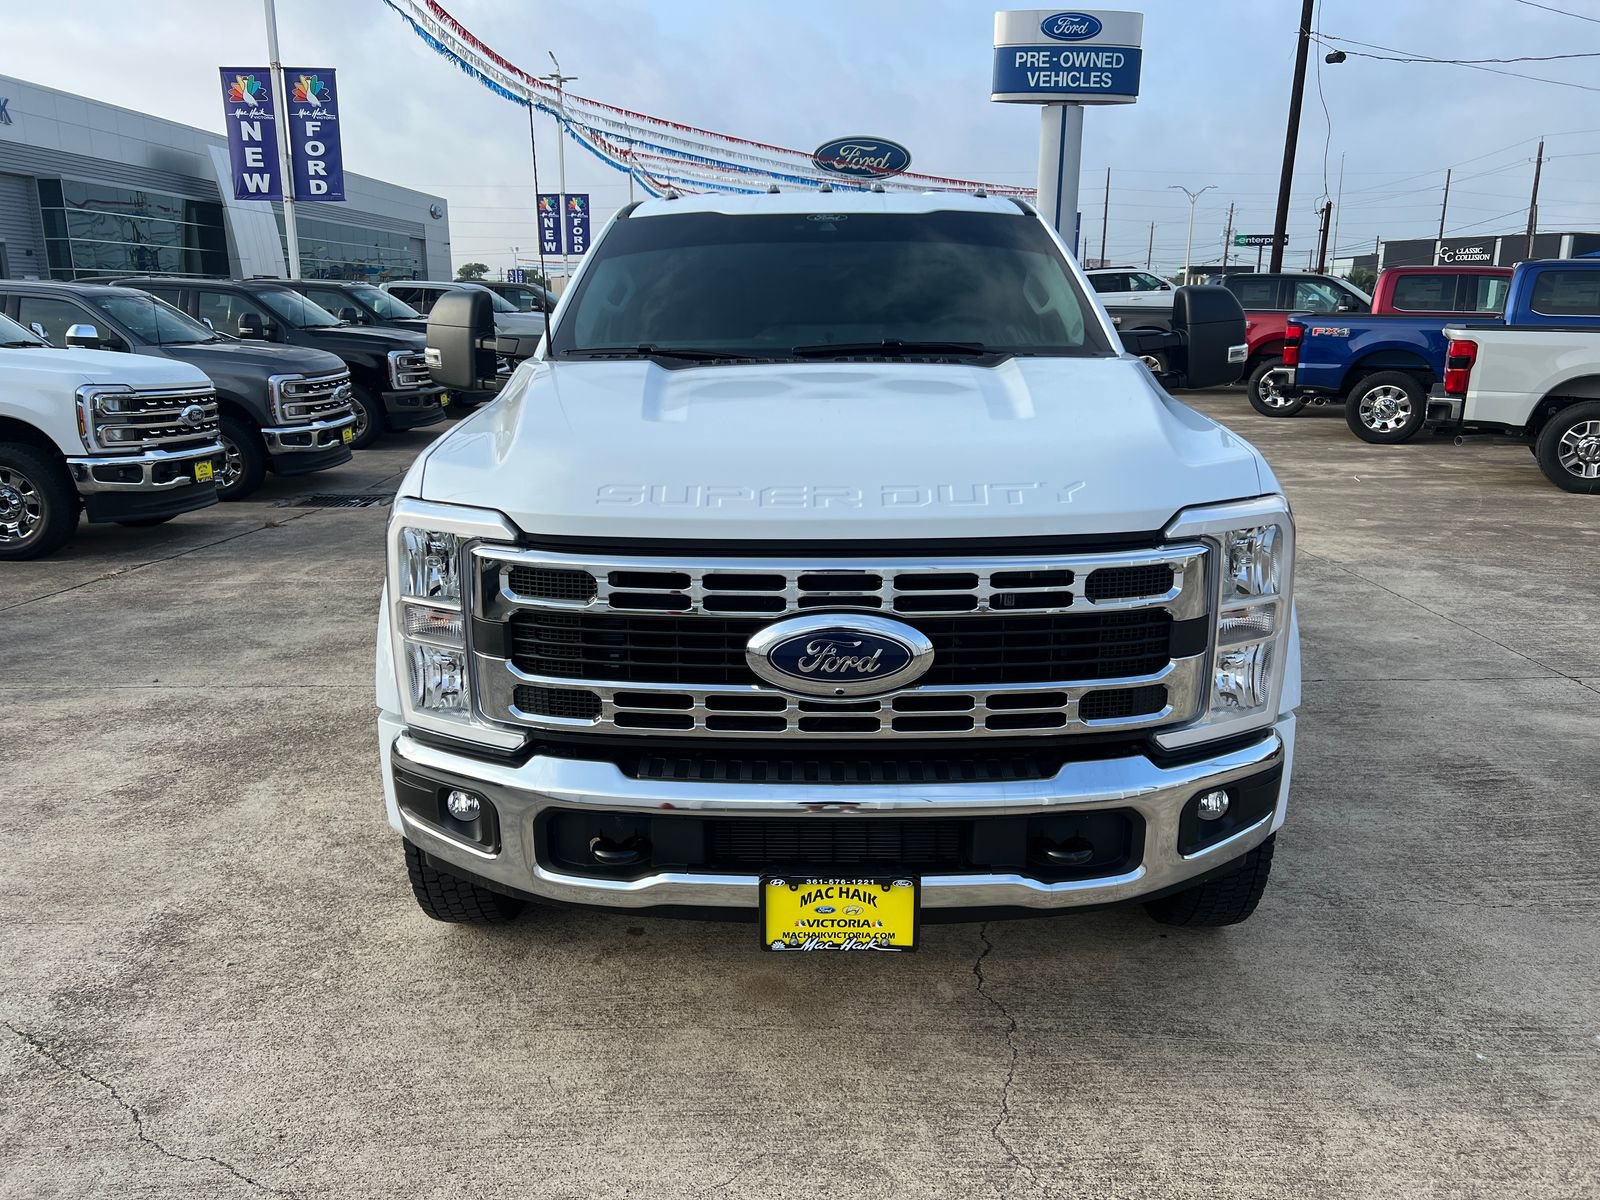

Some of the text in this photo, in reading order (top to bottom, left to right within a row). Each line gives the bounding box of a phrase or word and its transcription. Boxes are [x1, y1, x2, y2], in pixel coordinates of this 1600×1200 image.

[1053, 16, 1089, 34] Ford
[1015, 51, 1125, 68] PRE-OWNED
[1027, 71, 1112, 88] VEHICLES
[240, 120, 270, 193] NEW
[304, 121, 328, 195] FORD
[833, 144, 892, 170] Ford
[544, 218, 556, 252] NEW
[573, 218, 584, 253] FORD
[1312, 327, 1350, 337] FX4
[595, 481, 1086, 509] SUPER DUTY
[798, 639, 883, 673] Ford
[800, 886, 878, 908] MAC HAIK
[806, 919, 871, 928] VICTORIA
[782, 931, 896, 939] MACHAIKVICTORIA.COM
[800, 937, 882, 951] Mac Haik
